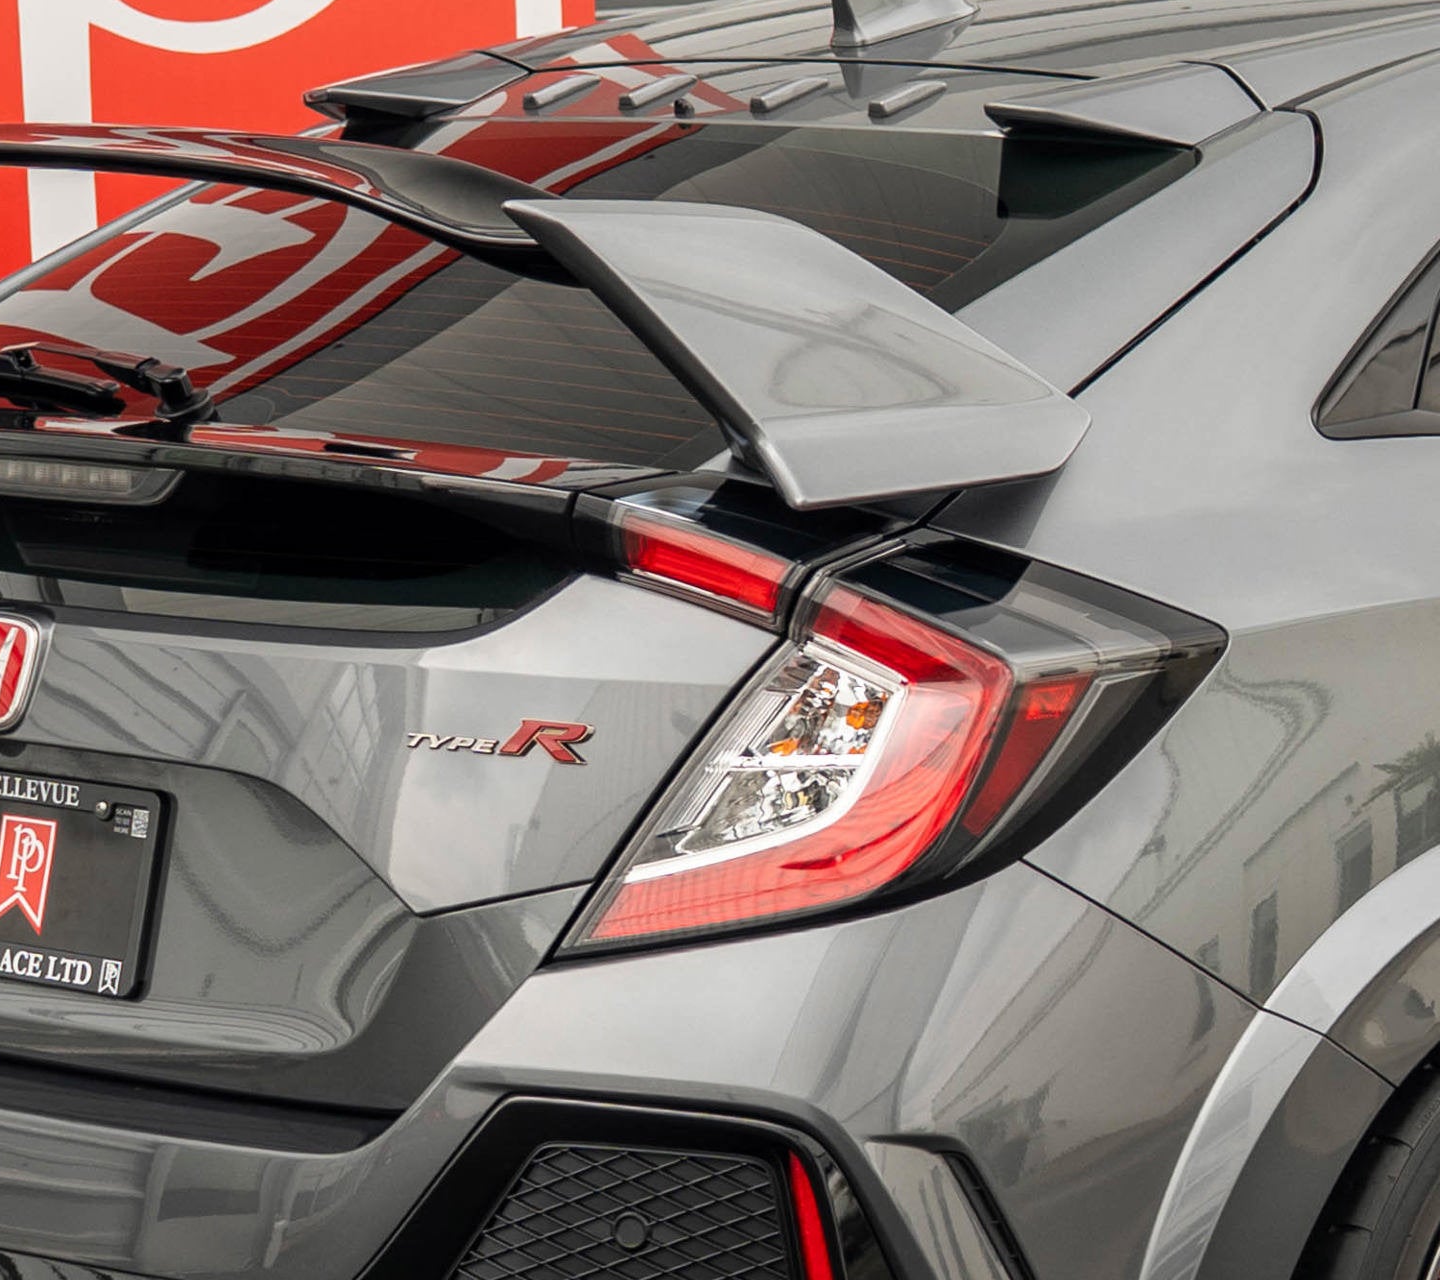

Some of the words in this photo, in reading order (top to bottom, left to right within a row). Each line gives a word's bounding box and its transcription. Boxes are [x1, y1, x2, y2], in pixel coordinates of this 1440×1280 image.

[407, 732, 500, 755] TYPE
[497, 718, 595, 765] R
[45, 956, 93, 985] LTD
